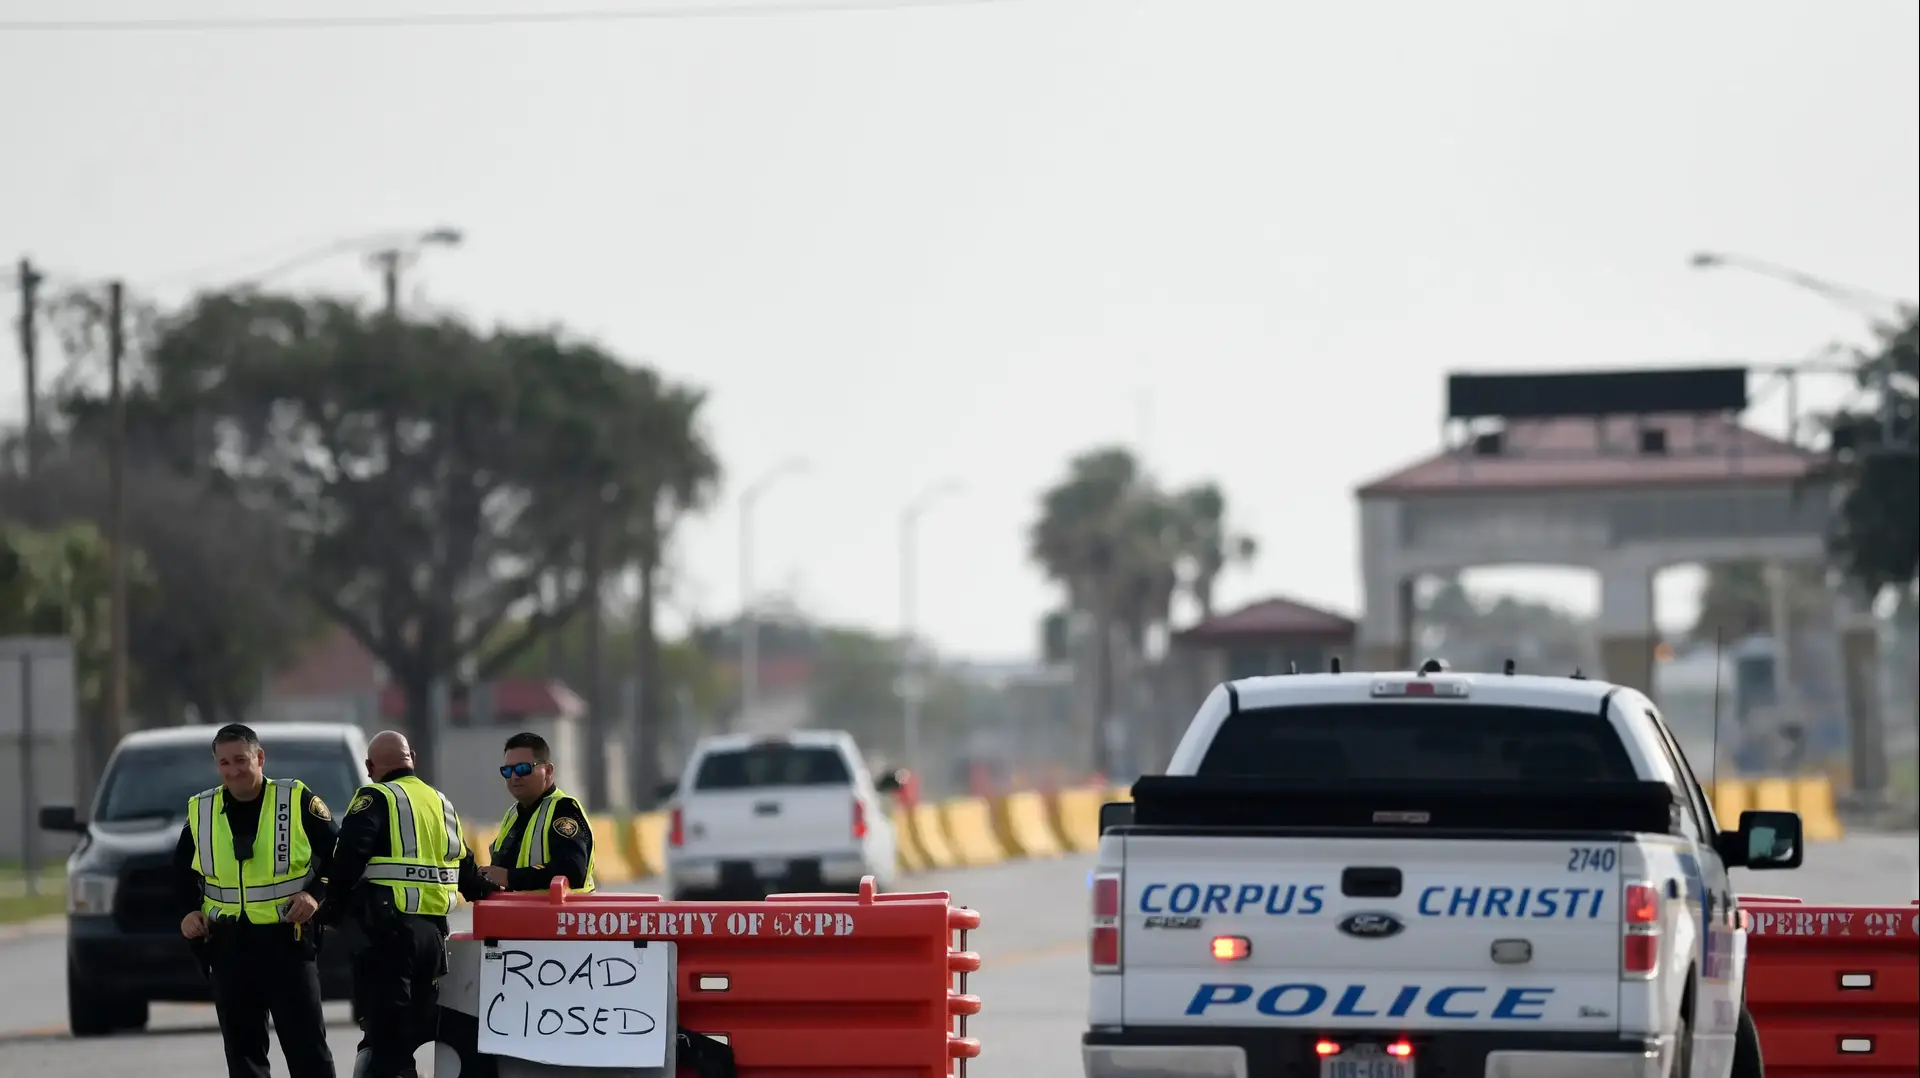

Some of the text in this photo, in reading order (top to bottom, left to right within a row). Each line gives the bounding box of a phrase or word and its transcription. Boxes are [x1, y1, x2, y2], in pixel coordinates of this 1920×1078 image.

[278, 803, 288, 862] POLICE
[405, 866, 455, 882] POLCE
[1567, 848, 1616, 872] 2740
[1139, 883, 1604, 918] CORPUS CHRISTI
[556, 912, 855, 936] PROPERTY OF CCPD
[1864, 912, 1902, 936] OF
[502, 950, 637, 990] ROAD
[1184, 983, 1555, 1020] POLICE
